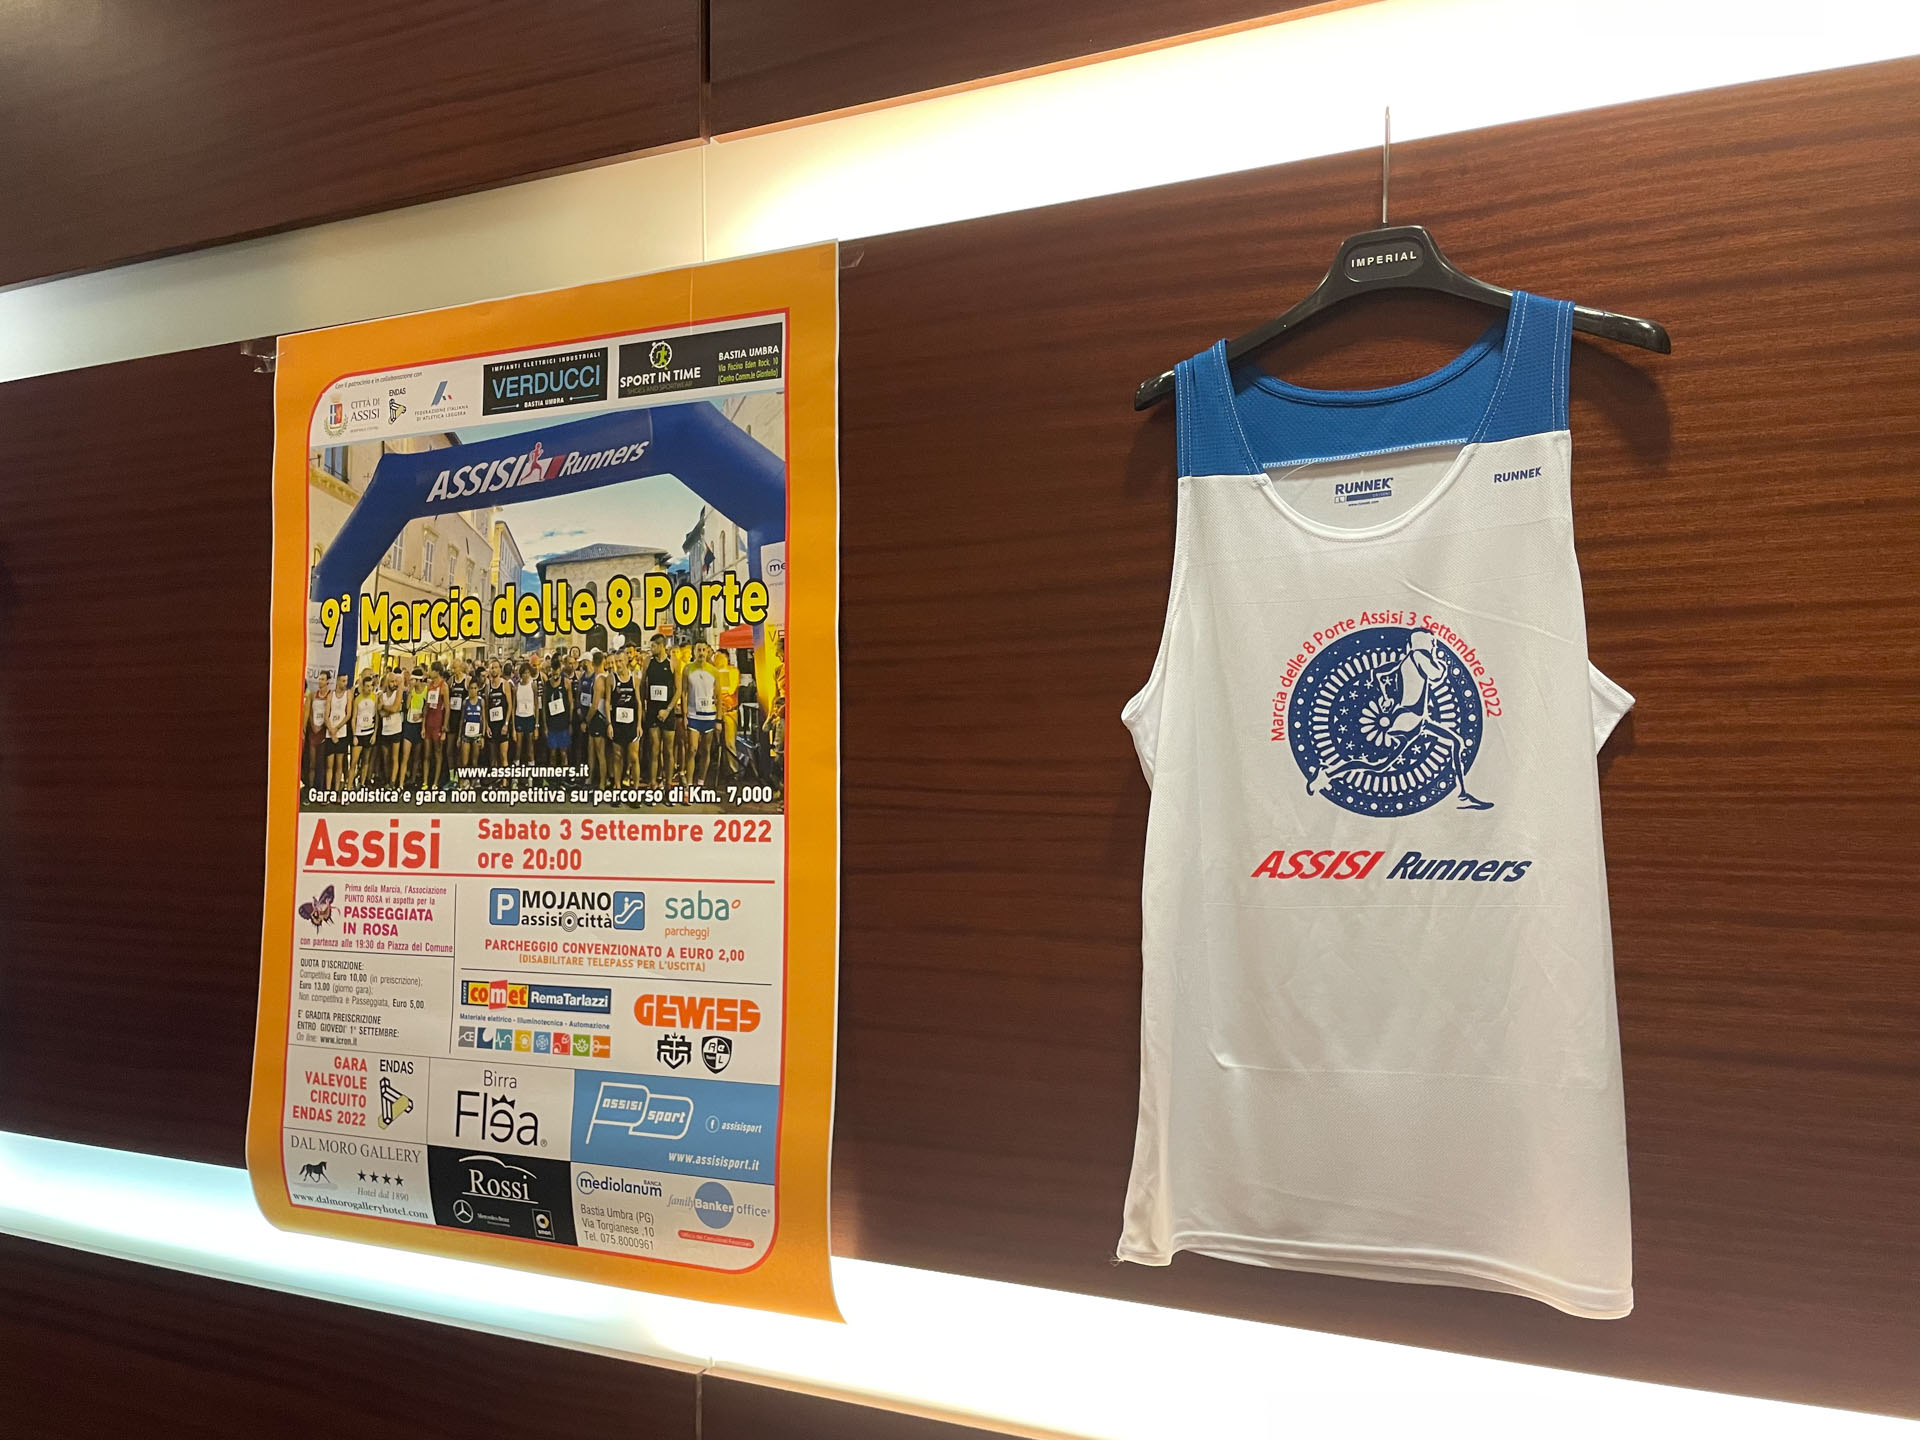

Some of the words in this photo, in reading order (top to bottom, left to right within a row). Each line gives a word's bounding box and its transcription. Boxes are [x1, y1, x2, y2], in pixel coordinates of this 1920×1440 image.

[1352, 251, 1416, 268] IMPERIAL
[492, 364, 520, 372] IMPIANTI
[524, 359, 556, 368] ELETTRICI
[559, 352, 600, 363] INDUSTRIALI
[719, 350, 747, 360] BASTIA
[749, 346, 779, 356] UMBRA
[492, 365, 600, 399] VERDUCCI
[620, 372, 656, 388] SPORT
[659, 371, 671, 382] IN
[673, 367, 700, 380] TIME
[389, 387, 406, 396] ENDAS
[351, 398, 370, 409] CITTÀ
[351, 408, 380, 421] ASSISI
[426, 454, 528, 502] ASSISI
[559, 441, 649, 476] Runners
[1494, 467, 1542, 483] RUNNEK
[1335, 477, 1390, 495] RUNNEK
[359, 586, 482, 645] Marcia
[491, 578, 597, 638] delle
[607, 574, 632, 631] 8
[644, 570, 768, 629] Porte
[1271, 691, 1288, 742] Marcia
[1280, 653, 1307, 688] delle
[1303, 642, 1316, 654] 8
[1313, 618, 1356, 646] Porte
[1360, 610, 1404, 625] Assisi
[1406, 612, 1417, 626] 3
[1419, 615, 1485, 676] Settembre
[1479, 677, 1503, 718] 2022
[457, 764, 589, 778] www.assisirunners.it
[309, 788, 336, 802] Gara
[341, 788, 398, 805] podistica
[403, 790, 412, 802] e
[416, 790, 446, 805] gara
[451, 790, 476, 802] non
[481, 787, 566, 806] competitiva
[570, 789, 586, 802] su
[593, 788, 663, 805] percorso
[669, 786, 683, 802] di
[688, 786, 720, 802] Km.
[727, 786, 772, 805] 7,000
[478, 818, 551, 841] Sabato
[560, 819, 572, 840] 3
[581, 819, 703, 841] Settembre
[713, 820, 772, 842] 2022
[305, 818, 440, 869] Assisi
[478, 852, 513, 869] ore
[522, 848, 582, 870] 20:00
[1250, 850, 1386, 880] ASSISI
[1386, 851, 1533, 882] Runners
[381, 885, 402, 894] Marcia,
[522, 891, 611, 910] MOJANO
[665, 890, 729, 920] saba
[344, 906, 433, 921] PASSEGGIATA
[343, 922, 356, 934] IN
[363, 923, 398, 936] ROSA
[665, 926, 710, 940] parcheggi
[356, 940, 374, 949] 19:30
[388, 941, 408, 950] Piazza
[412, 942, 422, 951] del
[425, 942, 453, 952] Comune
[485, 939, 558, 952] PARCHEGGIO
[562, 942, 662, 958] CONVENZIONATO
[667, 947, 675, 958] A
[680, 948, 713, 960] EURO
[719, 950, 744, 962] 2,00
[300, 958, 319, 968] QUOTA
[322, 960, 364, 970] D'ISCRIZIONE:
[520, 954, 584, 965] (DISABILITARE
[588, 958, 633, 968] TELEPASS
[637, 960, 655, 969] PER
[658, 961, 705, 972] L'USCITA)
[333, 972, 347, 981] Euro
[350, 974, 367, 983] 10,00
[300, 981, 311, 989] Euro
[332, 984, 353, 993] (giorno
[470, 985, 527, 1006] comet
[531, 992, 608, 1007] RemaTarlazzi
[393, 999, 407, 1007] Euro
[410, 1000, 424, 1008] 5,00
[305, 1010, 330, 1020] GRADITA
[333, 1013, 381, 1024] PREISCRIZIONE
[634, 994, 760, 1032] GEWISS
[297, 1021, 316, 1030] ENTRO
[359, 1027, 399, 1038] SETTEMBRE:
[569, 1021, 609, 1029] Automazione
[320, 1035, 357, 1046] www.icron.it
[334, 1056, 367, 1072] GARA
[380, 1059, 414, 1074] ENDAS
[305, 1071, 367, 1090] VALEVOLE
[484, 1070, 517, 1088] Birra
[310, 1089, 366, 1108] CIRCUITO
[293, 1105, 332, 1122] ENDAS
[338, 1112, 366, 1126] 2022
[602, 1098, 642, 1111] assisi
[648, 1110, 686, 1124] sport
[721, 1121, 762, 1134] assisisport
[291, 1135, 315, 1150] DAL
[319, 1138, 356, 1155] MORO
[361, 1144, 422, 1163] GALLERY
[668, 1152, 760, 1170] www.assisisport.it
[469, 1169, 530, 1200] Rossi
[580, 1176, 662, 1197] mediolanum
[358, 1187, 376, 1198] Hotel
[378, 1189, 389, 1198] dal
[392, 1188, 408, 1201] 1890
[292, 1193, 428, 1218] www.dalmorogalleryhotel.com
[581, 1204, 604, 1217] Bastia
[607, 1208, 633, 1220] Umbra
[636, 1212, 654, 1225] (PG)
[582, 1217, 595, 1229] Via
[597, 1219, 639, 1234] Torgianese
[584, 1231, 596, 1242] Tel.
[601, 1234, 654, 1250] 075.8000961
